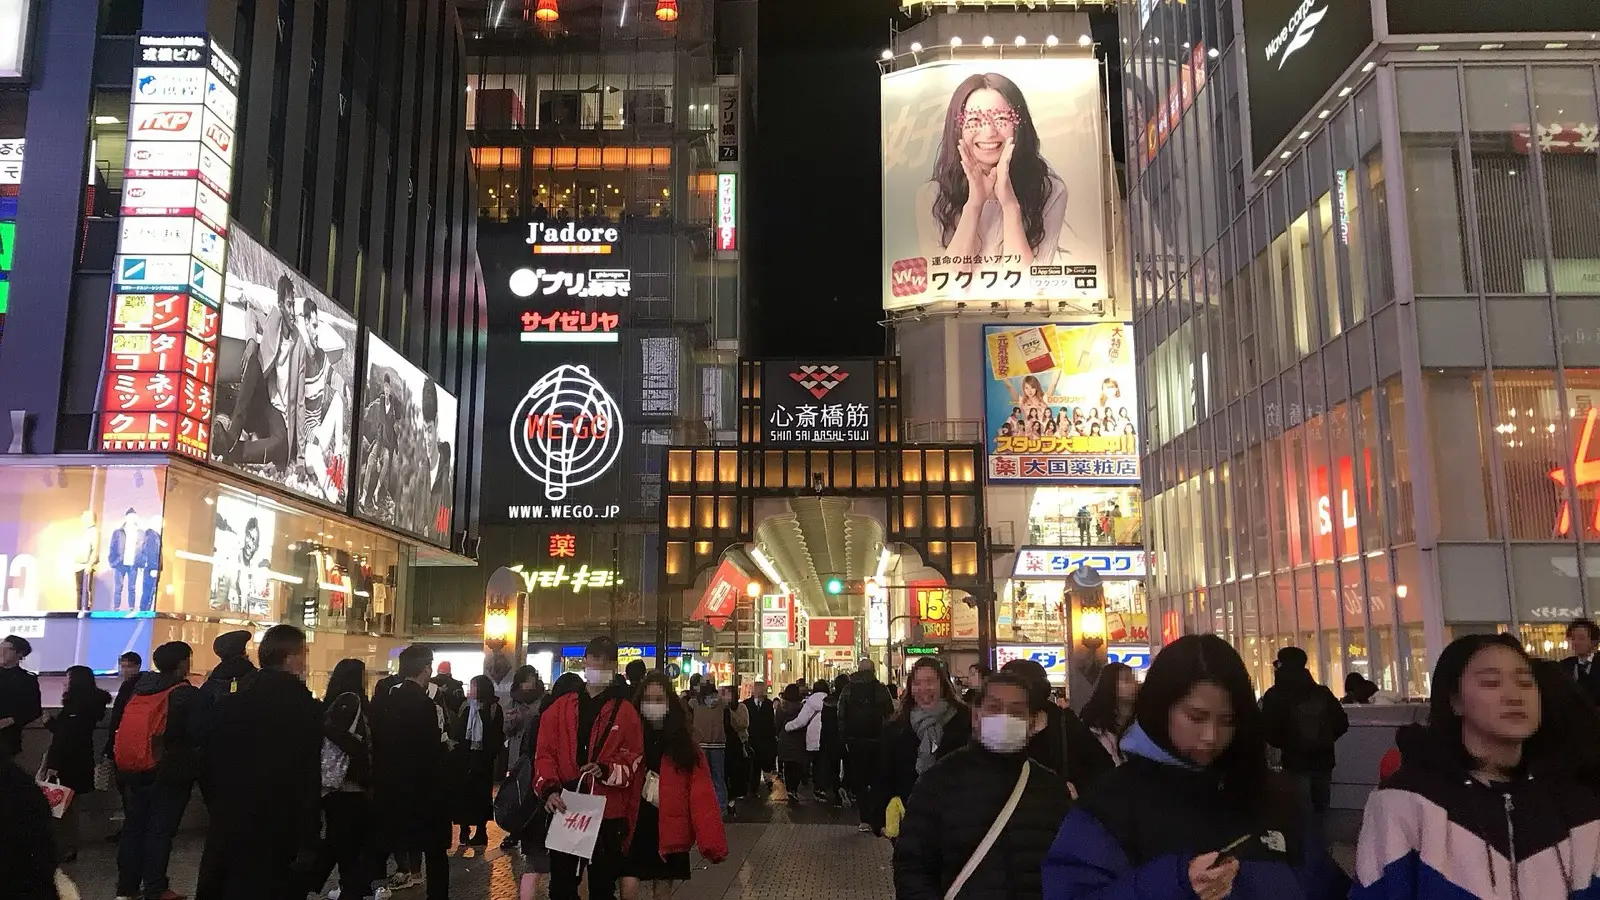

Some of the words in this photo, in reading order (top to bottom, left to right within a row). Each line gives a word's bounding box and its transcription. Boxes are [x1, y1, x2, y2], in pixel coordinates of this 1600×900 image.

[723, 147, 735, 156] 7F
[526, 222, 618, 244] J'adore
[932, 254, 1022, 266] 運命の出会いアプリ
[932, 270, 1021, 290] ワクワク
[521, 311, 619, 331] サイゼリヤ
[146, 295, 180, 433] インターネット
[110, 354, 140, 432] コミック
[770, 403, 869, 428] 心斎橋筋
[527, 414, 562, 440] WE
[572, 414, 608, 440] GO
[771, 431, 792, 441] SHIN
[1024, 459, 1136, 475] 大国薬粧店
[508, 505, 620, 519] WWW.WEGO.JP
[550, 535, 575, 557] 薬
[1051, 554, 1131, 571] ダイコク
[917, 590, 951, 621] 15%
